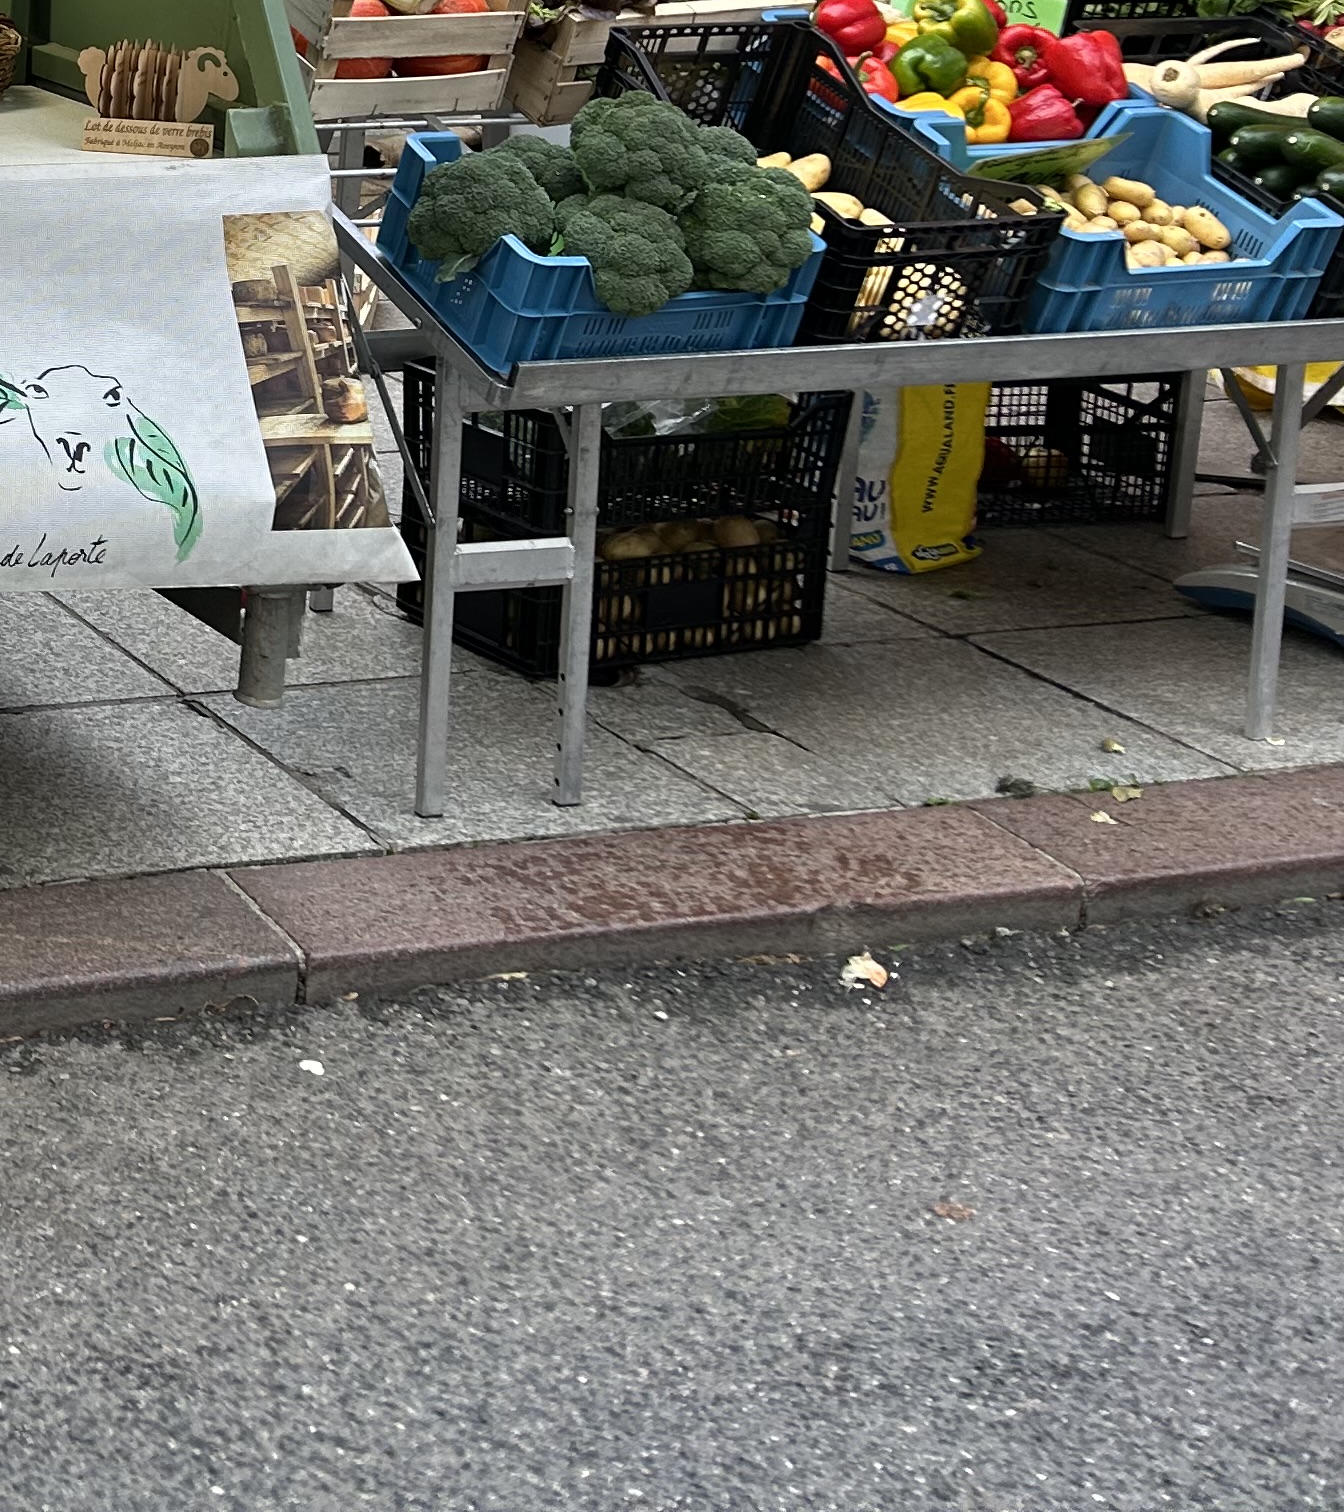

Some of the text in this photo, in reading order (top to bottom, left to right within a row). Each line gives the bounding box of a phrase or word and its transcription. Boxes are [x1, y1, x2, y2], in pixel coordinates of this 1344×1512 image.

[102, 121, 113, 131] de
[115, 120, 147, 134] dessous
[150, 123, 160, 134] de
